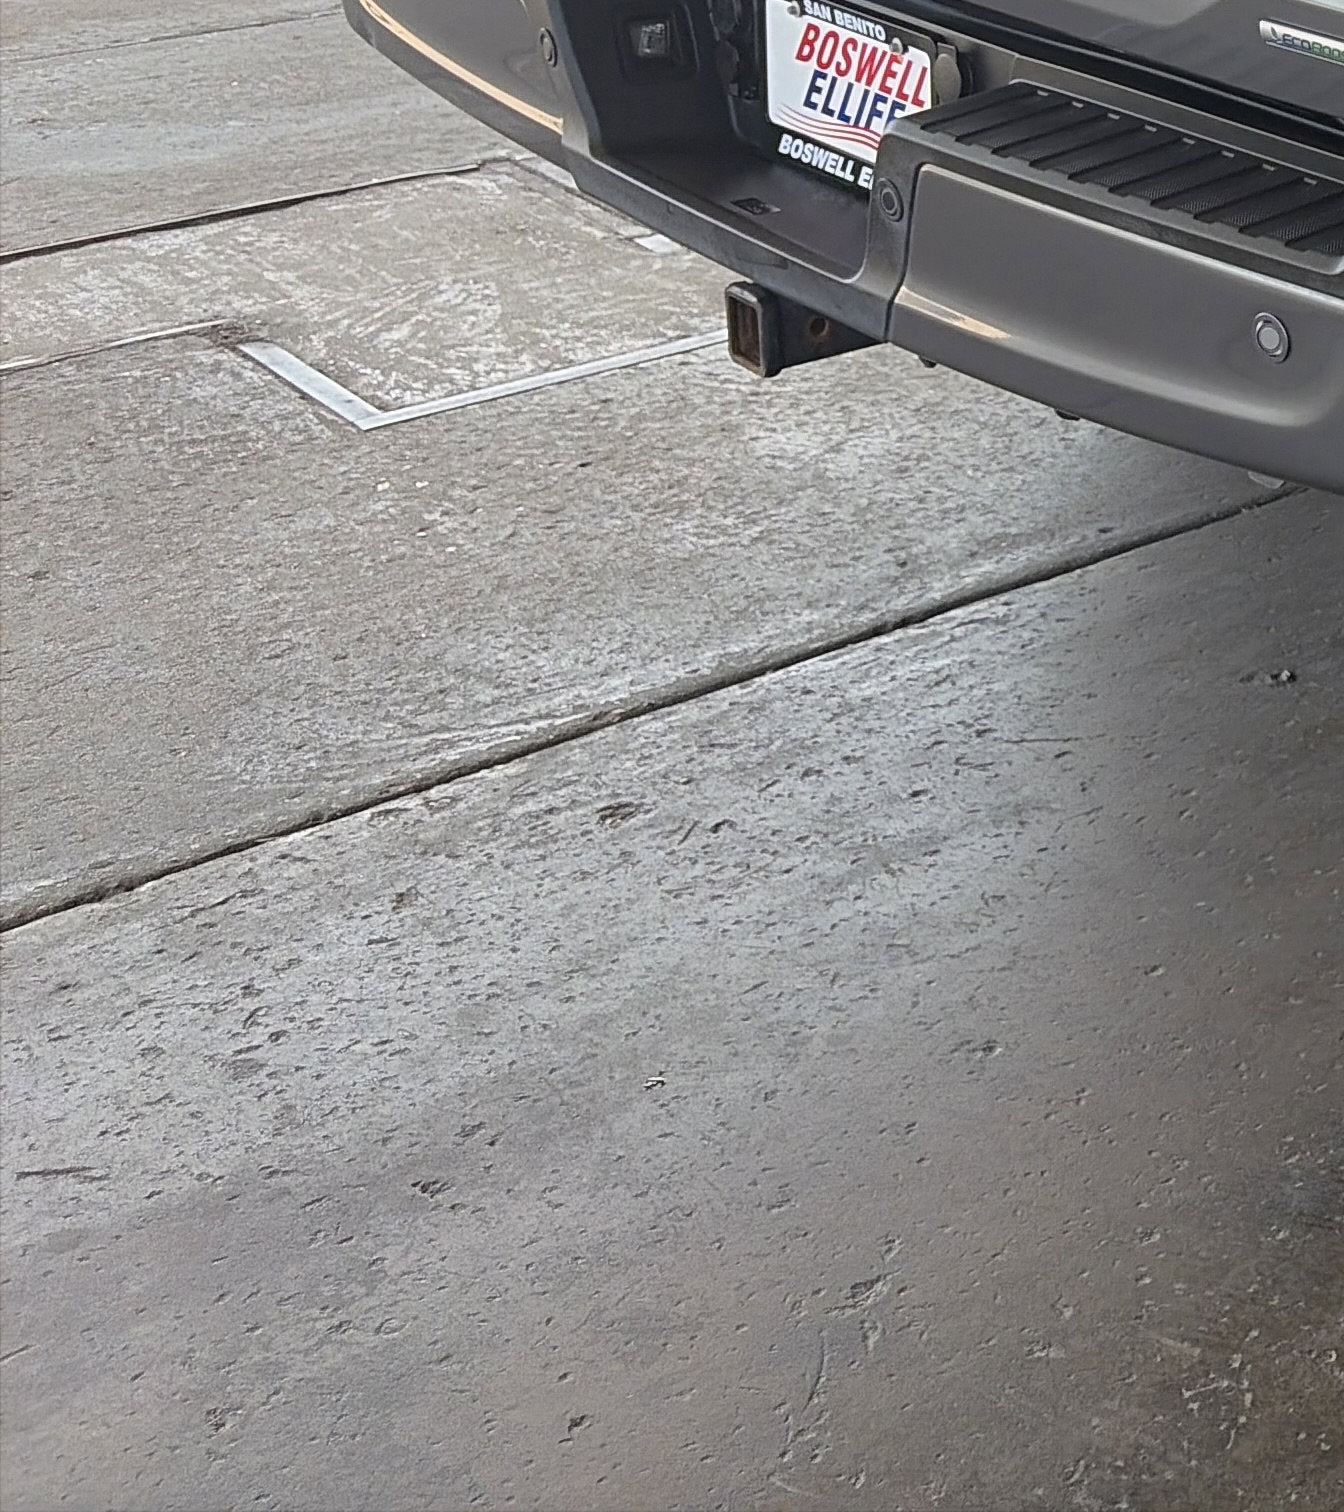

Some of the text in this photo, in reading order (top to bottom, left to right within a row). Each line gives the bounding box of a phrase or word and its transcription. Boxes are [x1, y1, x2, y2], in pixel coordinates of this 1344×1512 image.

[834, 9, 887, 42] BENITO
[795, 22, 928, 108] BOSWELL
[803, 69, 907, 132] ELLIFF
[778, 133, 855, 183] BOSWELL
